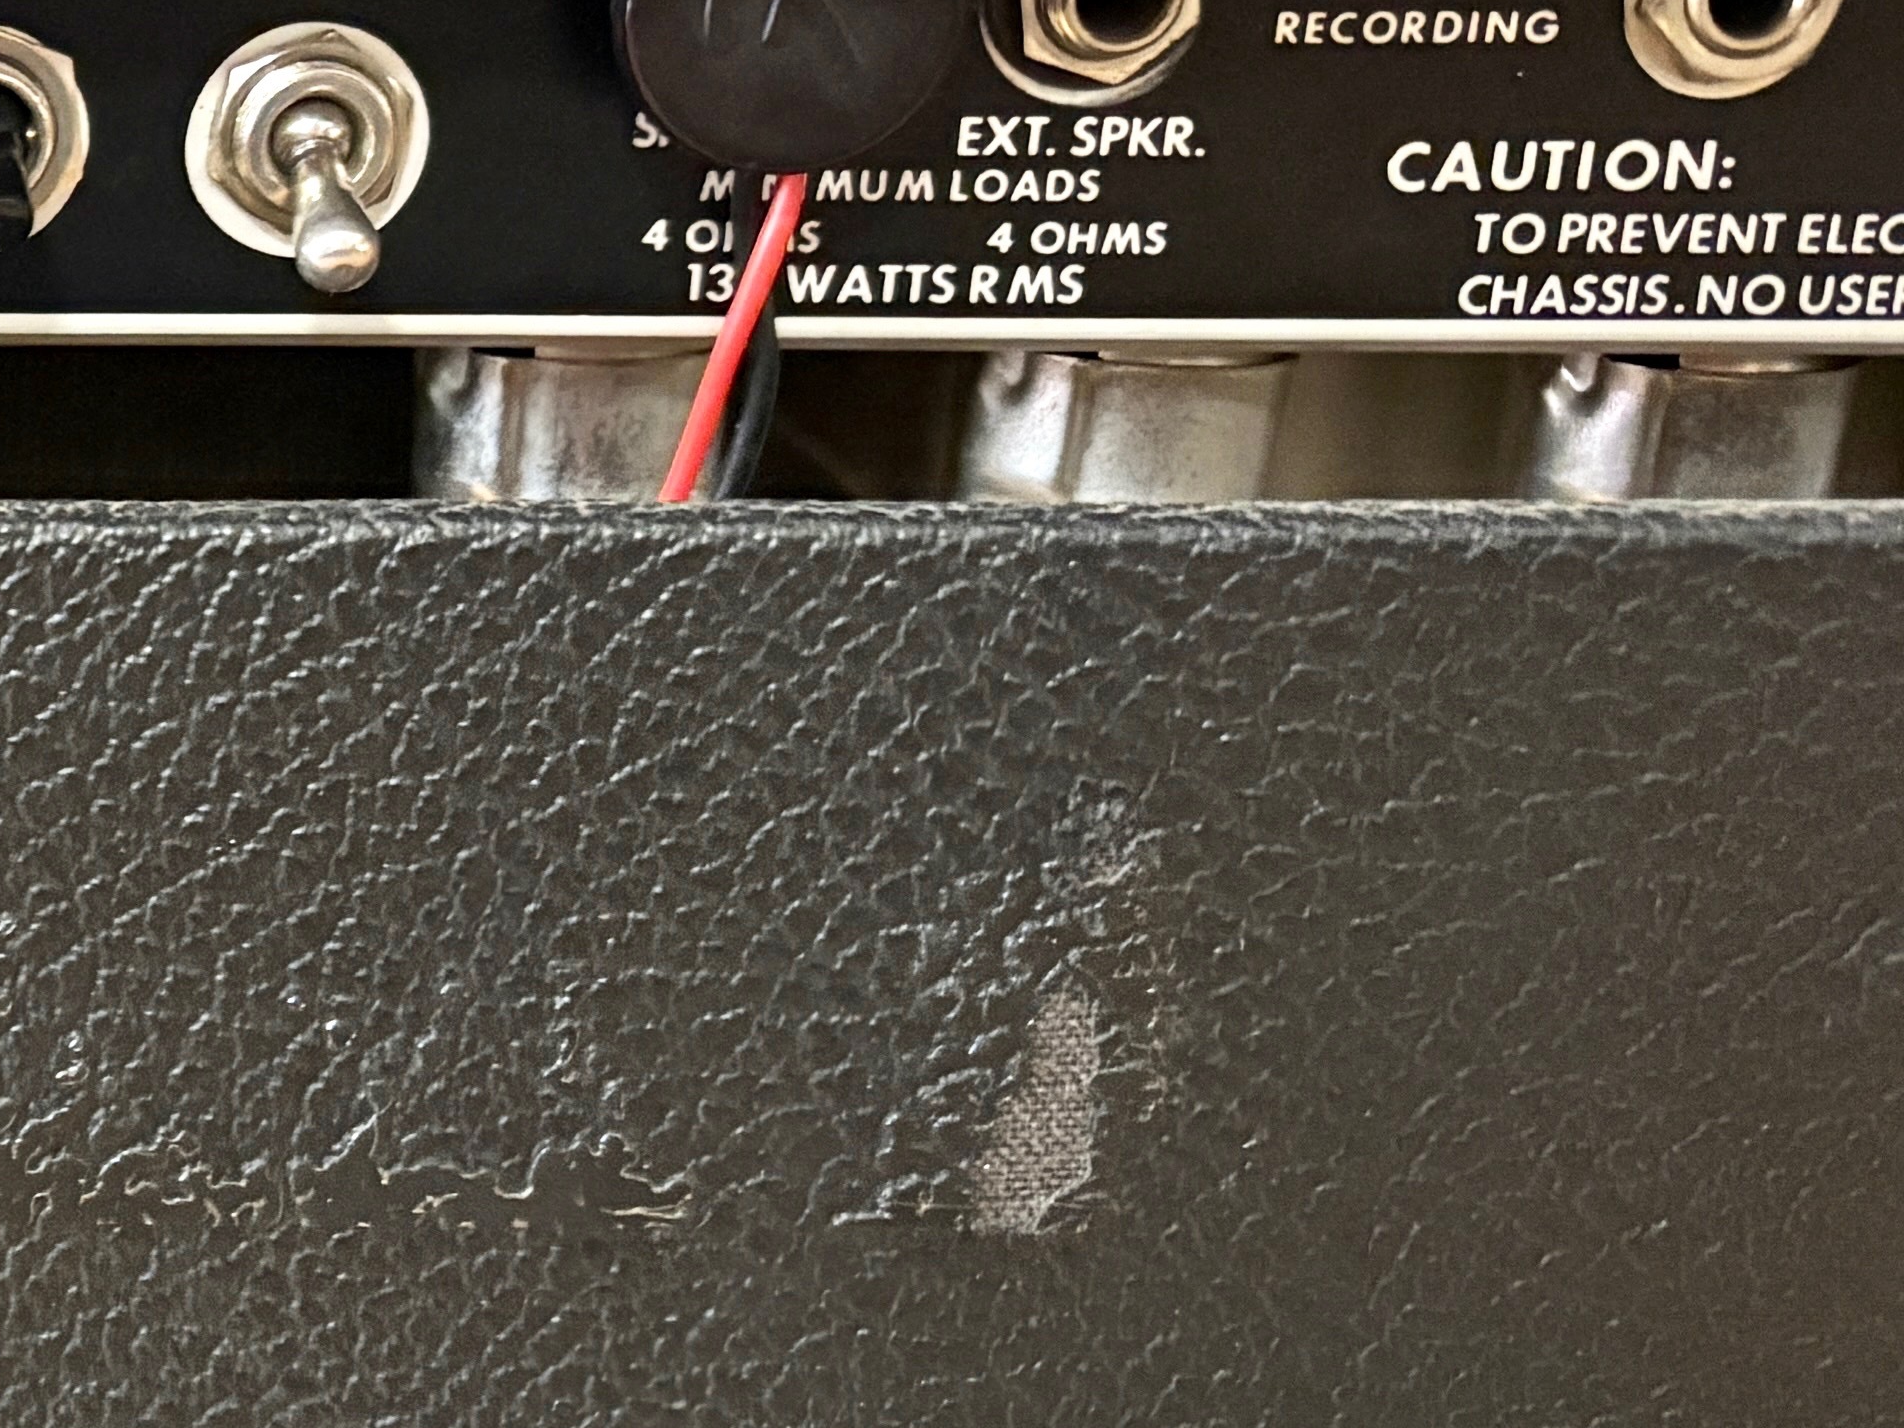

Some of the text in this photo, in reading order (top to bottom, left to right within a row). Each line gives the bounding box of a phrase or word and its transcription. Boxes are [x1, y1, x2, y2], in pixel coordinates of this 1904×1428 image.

[1273, 8, 1561, 46] RECORDING
[956, 114, 1207, 158] EXT. SPKR.
[949, 168, 1102, 203] LOADS
[1386, 138, 1737, 193] CAUTION:
[641, 218, 670, 253] 4
[986, 220, 1169, 256] 4 OHMS
[1474, 212, 1548, 255] TO
[1557, 212, 1788, 255] PREVENT
[687, 263, 1086, 305] 13 WATTS RMS
[1457, 273, 1686, 315] CHASSIS.
[1695, 273, 1787, 315] NO
